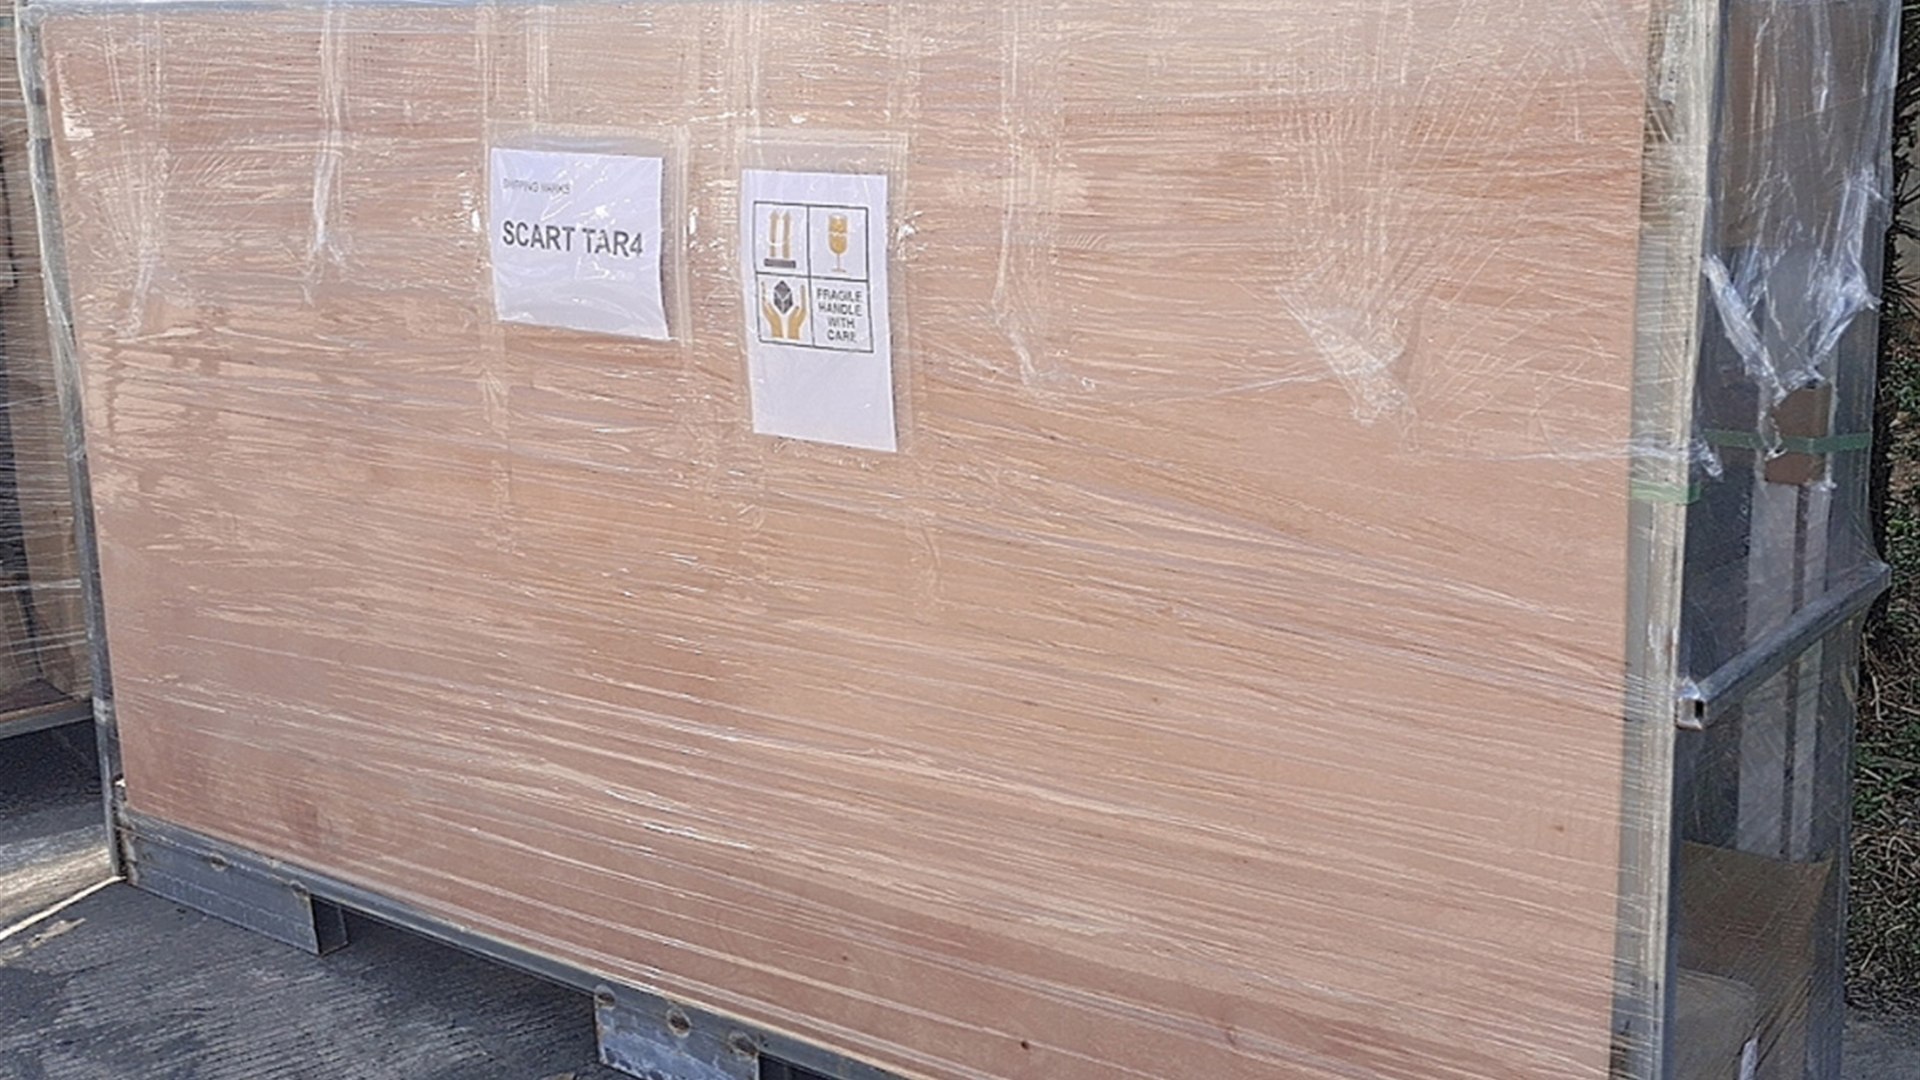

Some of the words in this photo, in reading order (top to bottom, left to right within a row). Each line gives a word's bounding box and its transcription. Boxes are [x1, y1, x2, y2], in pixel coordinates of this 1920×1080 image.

[503, 220, 575, 251] SCART
[582, 227, 643, 257] TAR4
[817, 288, 862, 303] FRAGILE
[818, 303, 862, 316] HANDLE
[828, 317, 856, 329] WITH
[827, 329, 858, 342] CARE
